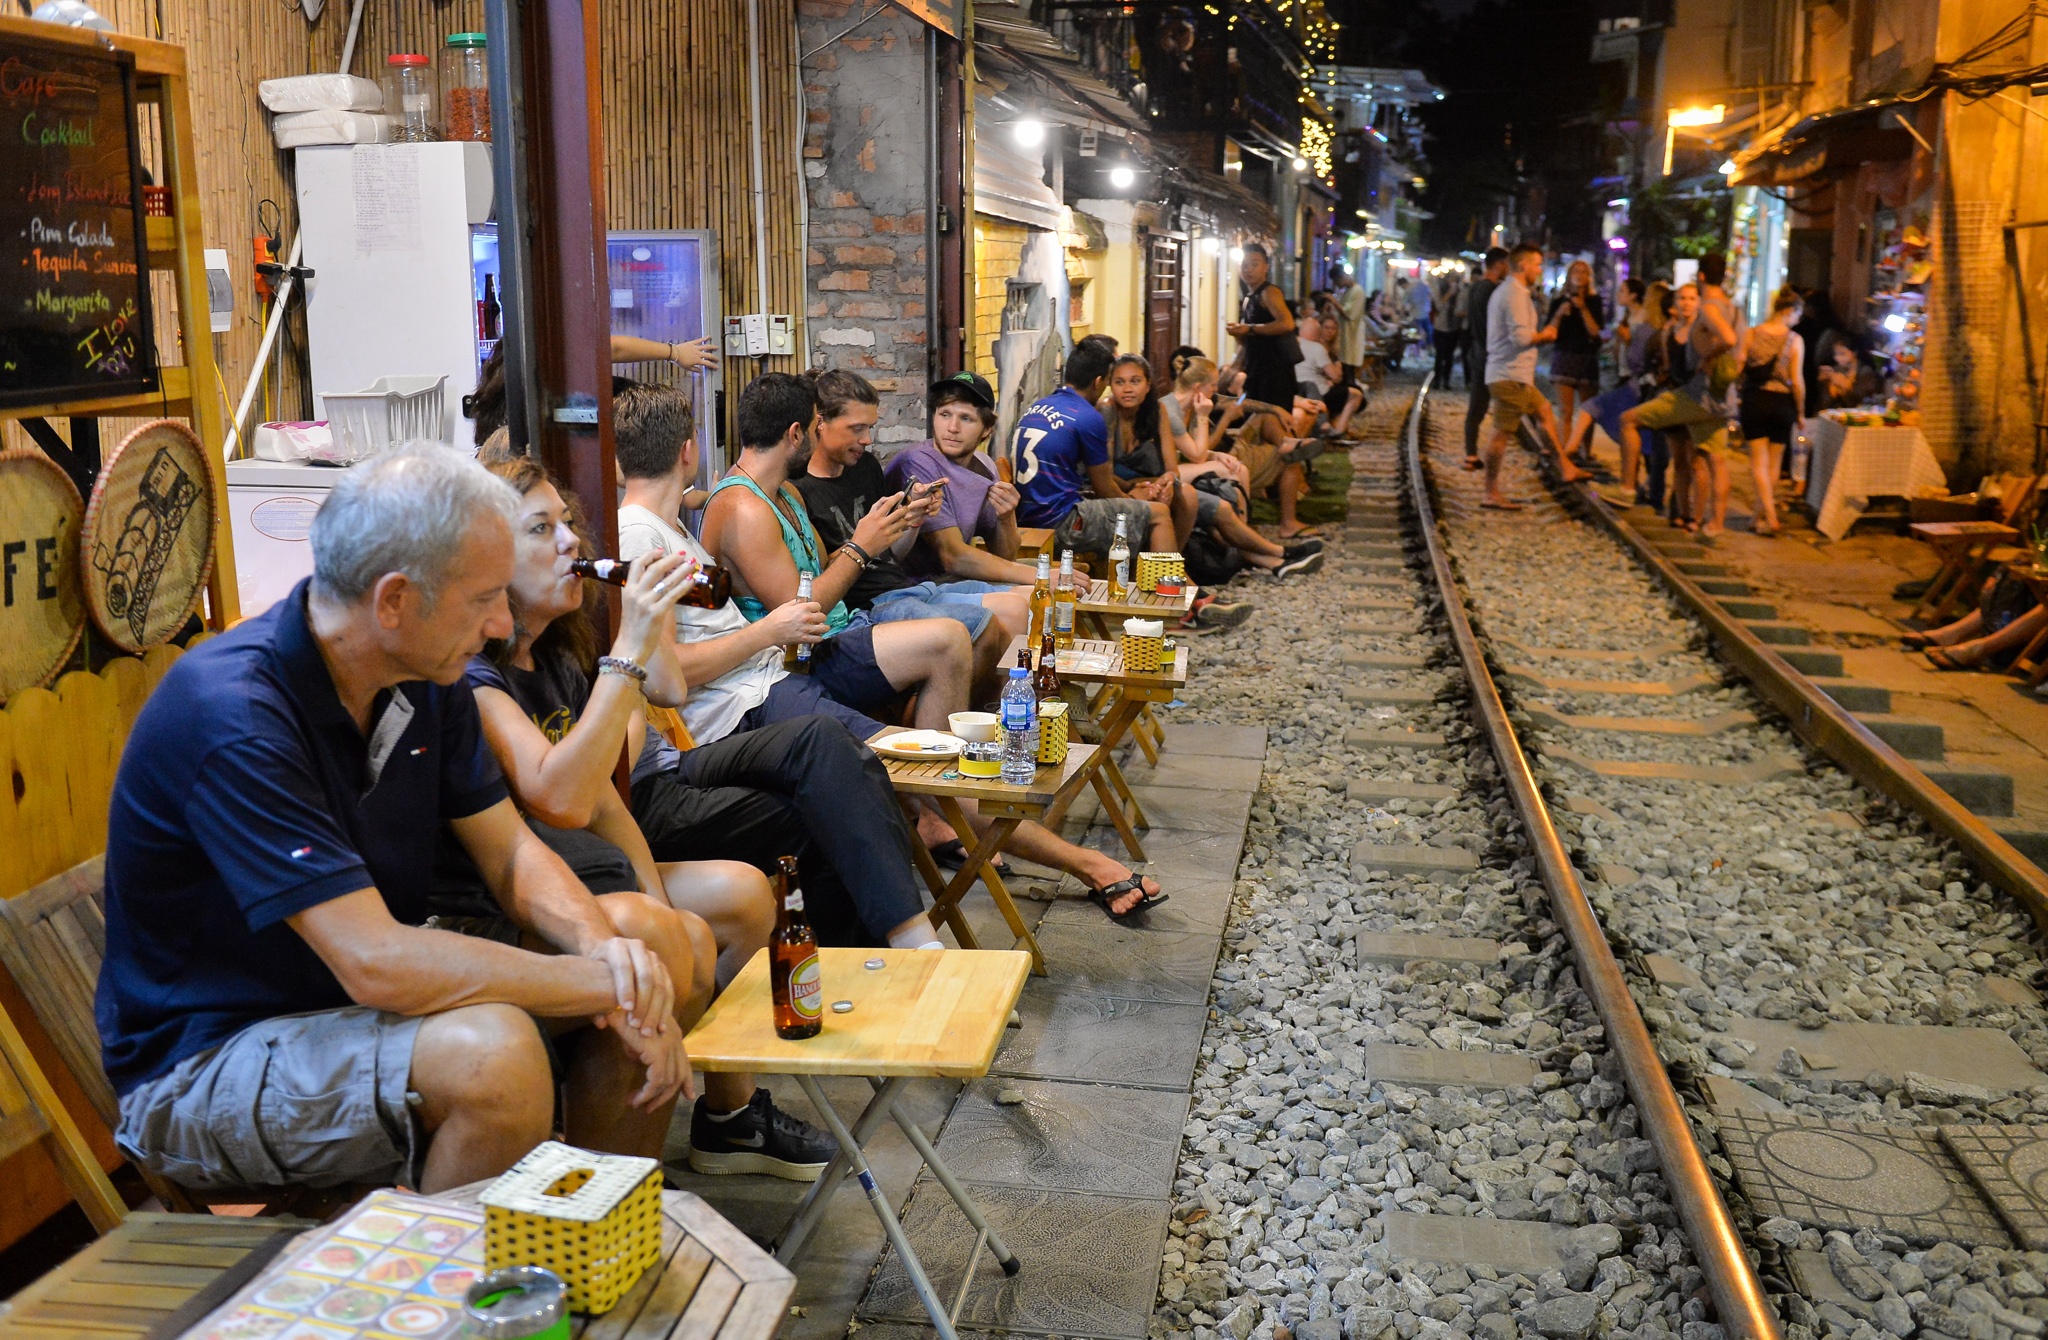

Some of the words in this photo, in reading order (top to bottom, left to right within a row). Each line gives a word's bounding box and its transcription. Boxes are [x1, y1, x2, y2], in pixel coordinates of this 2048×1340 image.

[22, 112, 96, 146] Cocktail
[68, 220, 115, 247] Colada
[32, 248, 87, 282] Tequila
[36, 288, 111, 323] Margarita
[1010, 427, 1049, 486] 13
